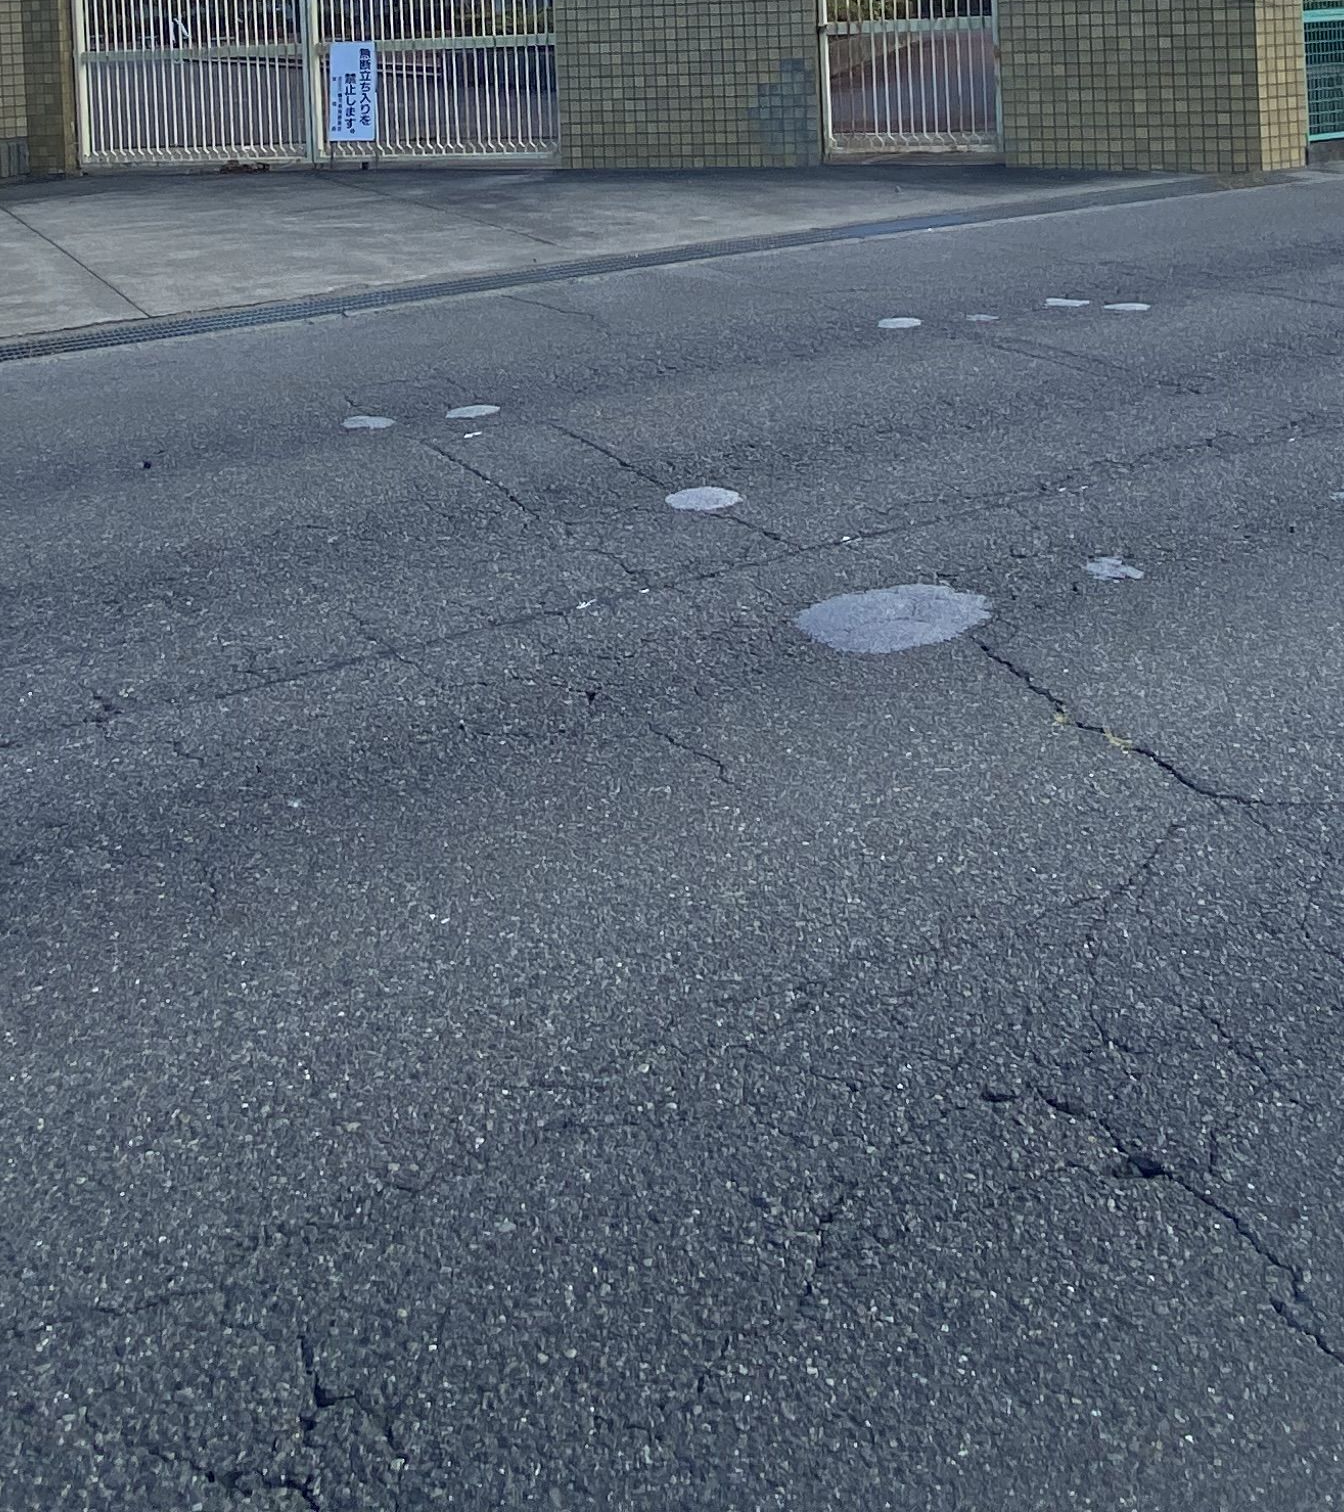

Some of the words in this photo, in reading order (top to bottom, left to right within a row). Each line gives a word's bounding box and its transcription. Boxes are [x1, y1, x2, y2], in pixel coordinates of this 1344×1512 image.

[345, 73, 356, 134] 禁止します。
[359, 48, 371, 126] 無断立ち入りを
